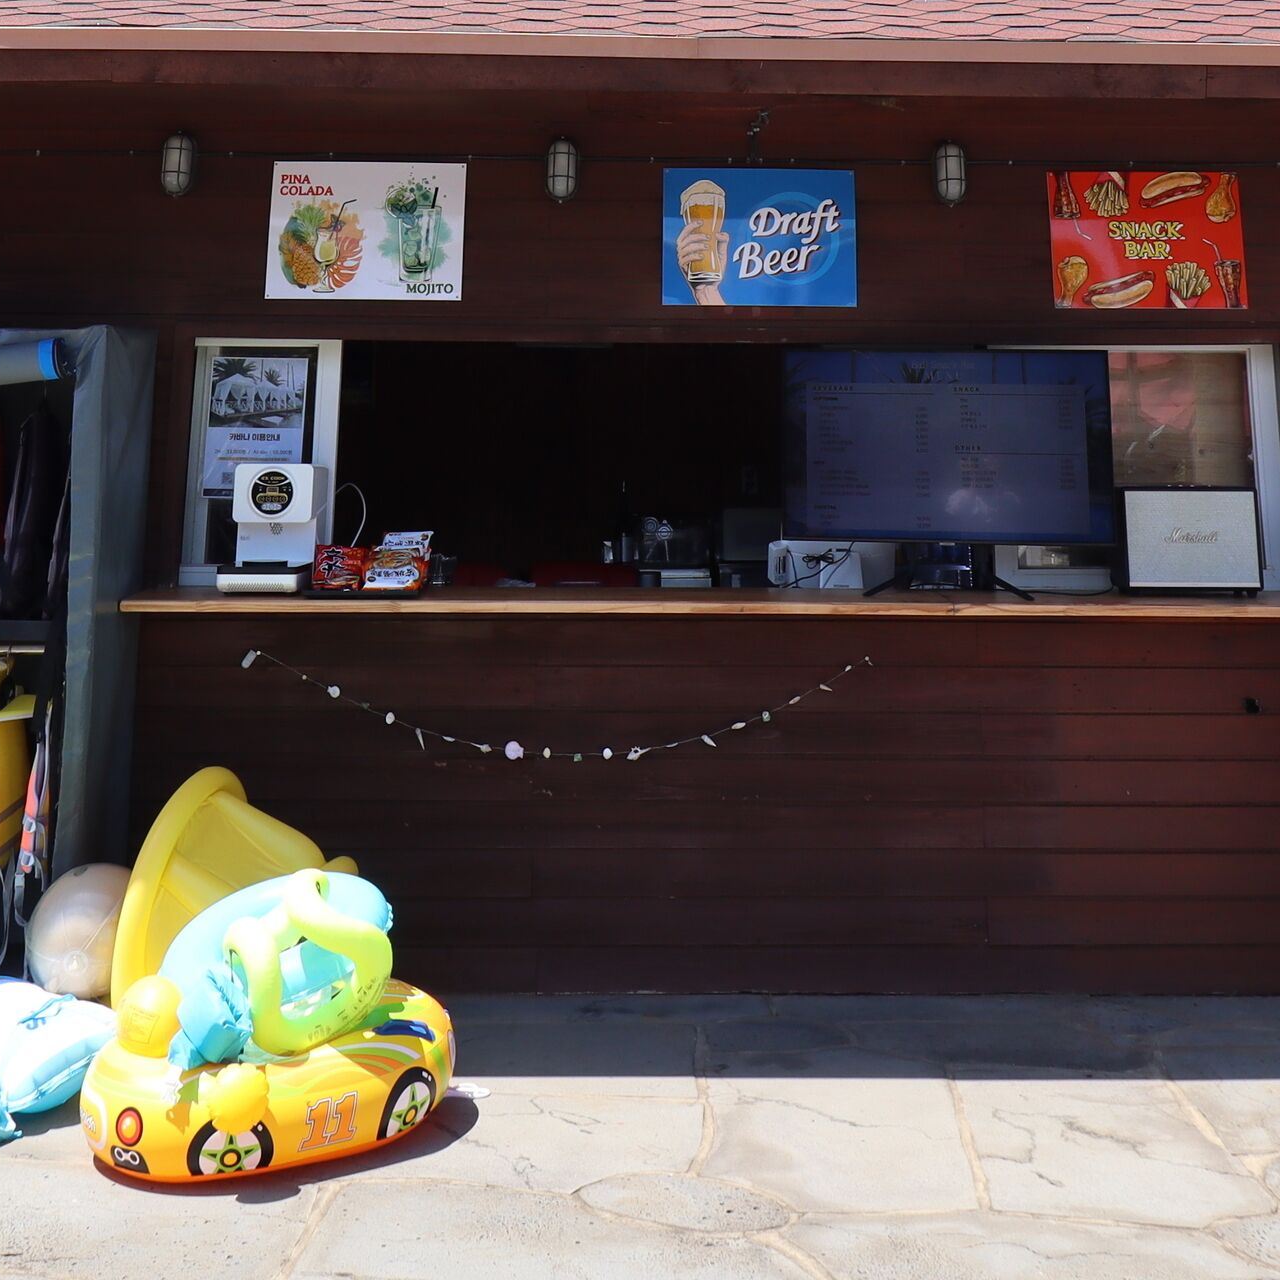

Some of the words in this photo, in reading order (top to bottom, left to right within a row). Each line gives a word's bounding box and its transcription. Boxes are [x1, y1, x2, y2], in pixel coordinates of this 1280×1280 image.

[280, 174, 311, 185] PINA
[280, 185, 333, 196] COLADA
[749, 199, 840, 245] Draft
[1107, 221, 1185, 240] SNACK
[1122, 240, 1174, 260] BAR
[732, 241, 821, 280] Beer
[406, 283, 454, 296] MOJITO
[1164, 527, 1218, 544] Marshall
[298, 1091, 358, 1151] 11
